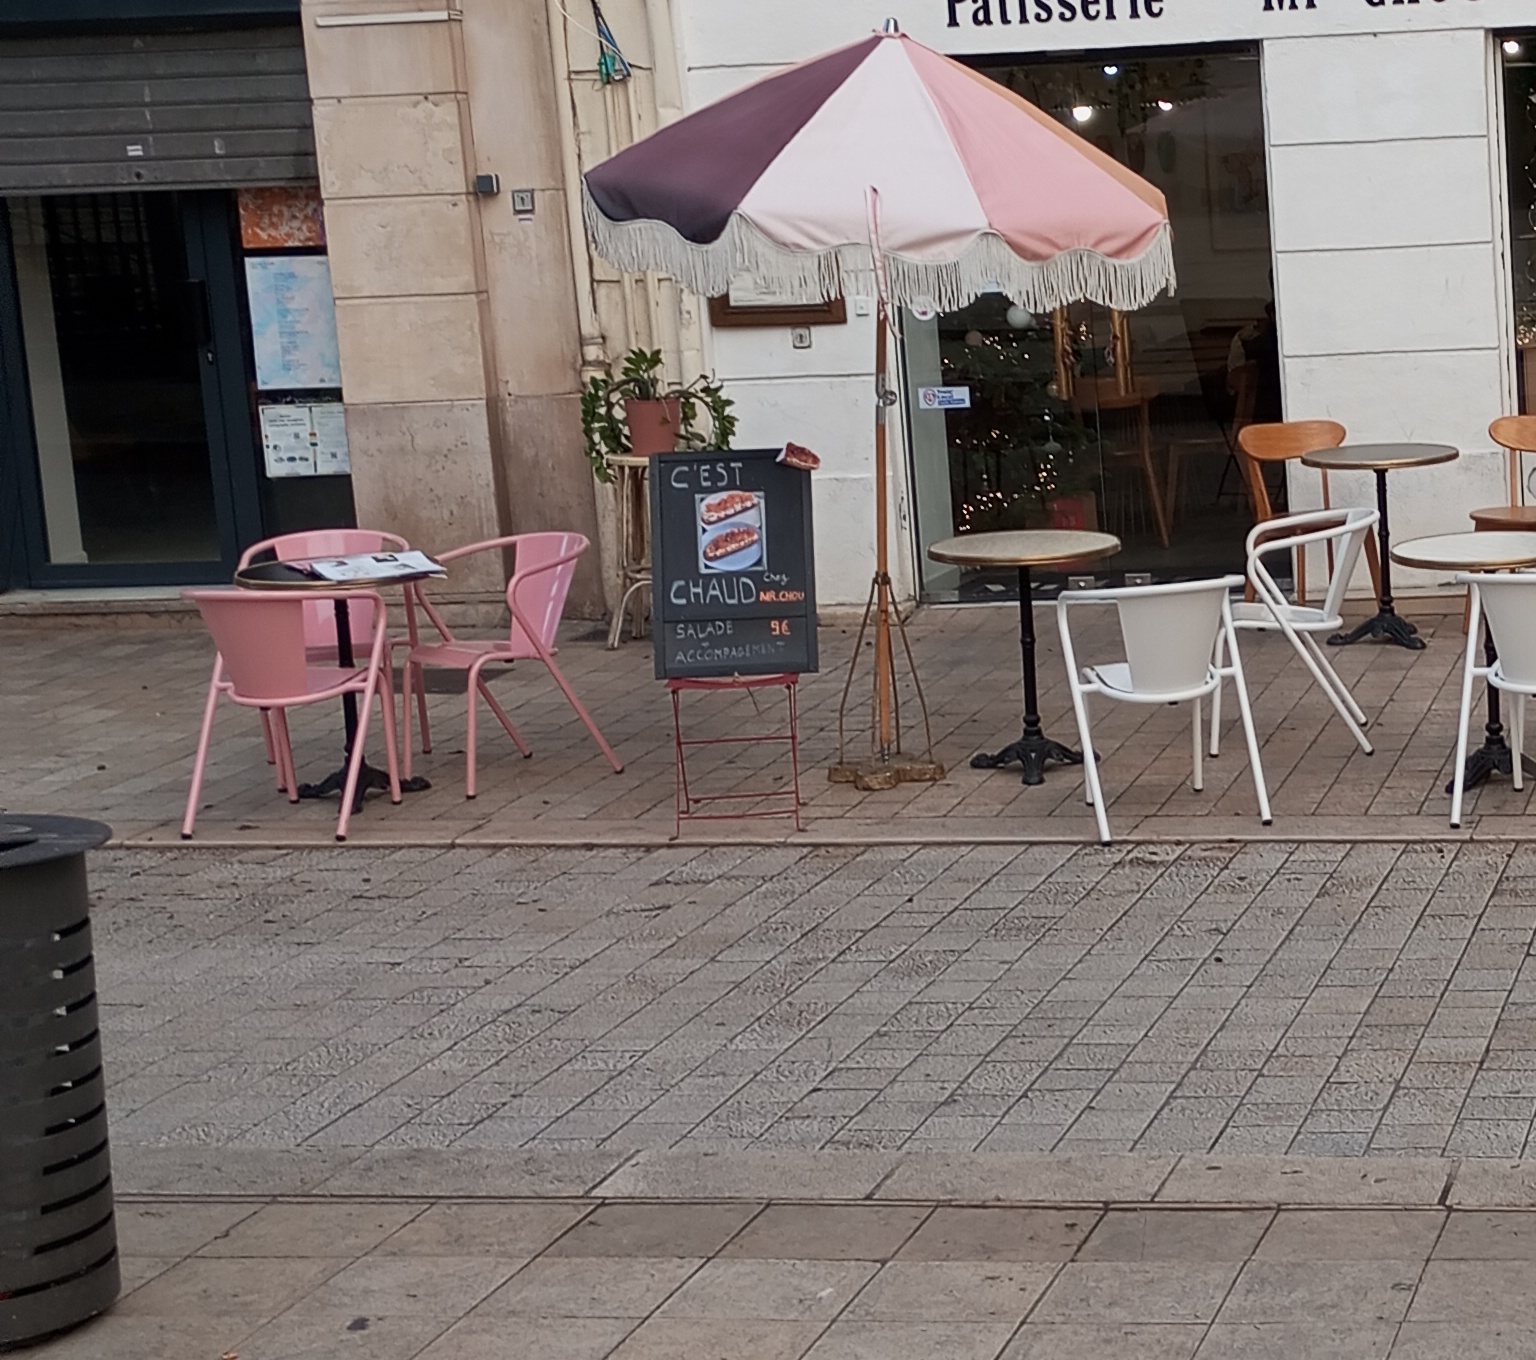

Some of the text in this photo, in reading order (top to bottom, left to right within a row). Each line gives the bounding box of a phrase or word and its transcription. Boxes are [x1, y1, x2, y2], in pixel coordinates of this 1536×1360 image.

[671, 462, 743, 488] C'EST
[670, 576, 756, 605] CHAUD
[676, 620, 733, 639] SALADE
